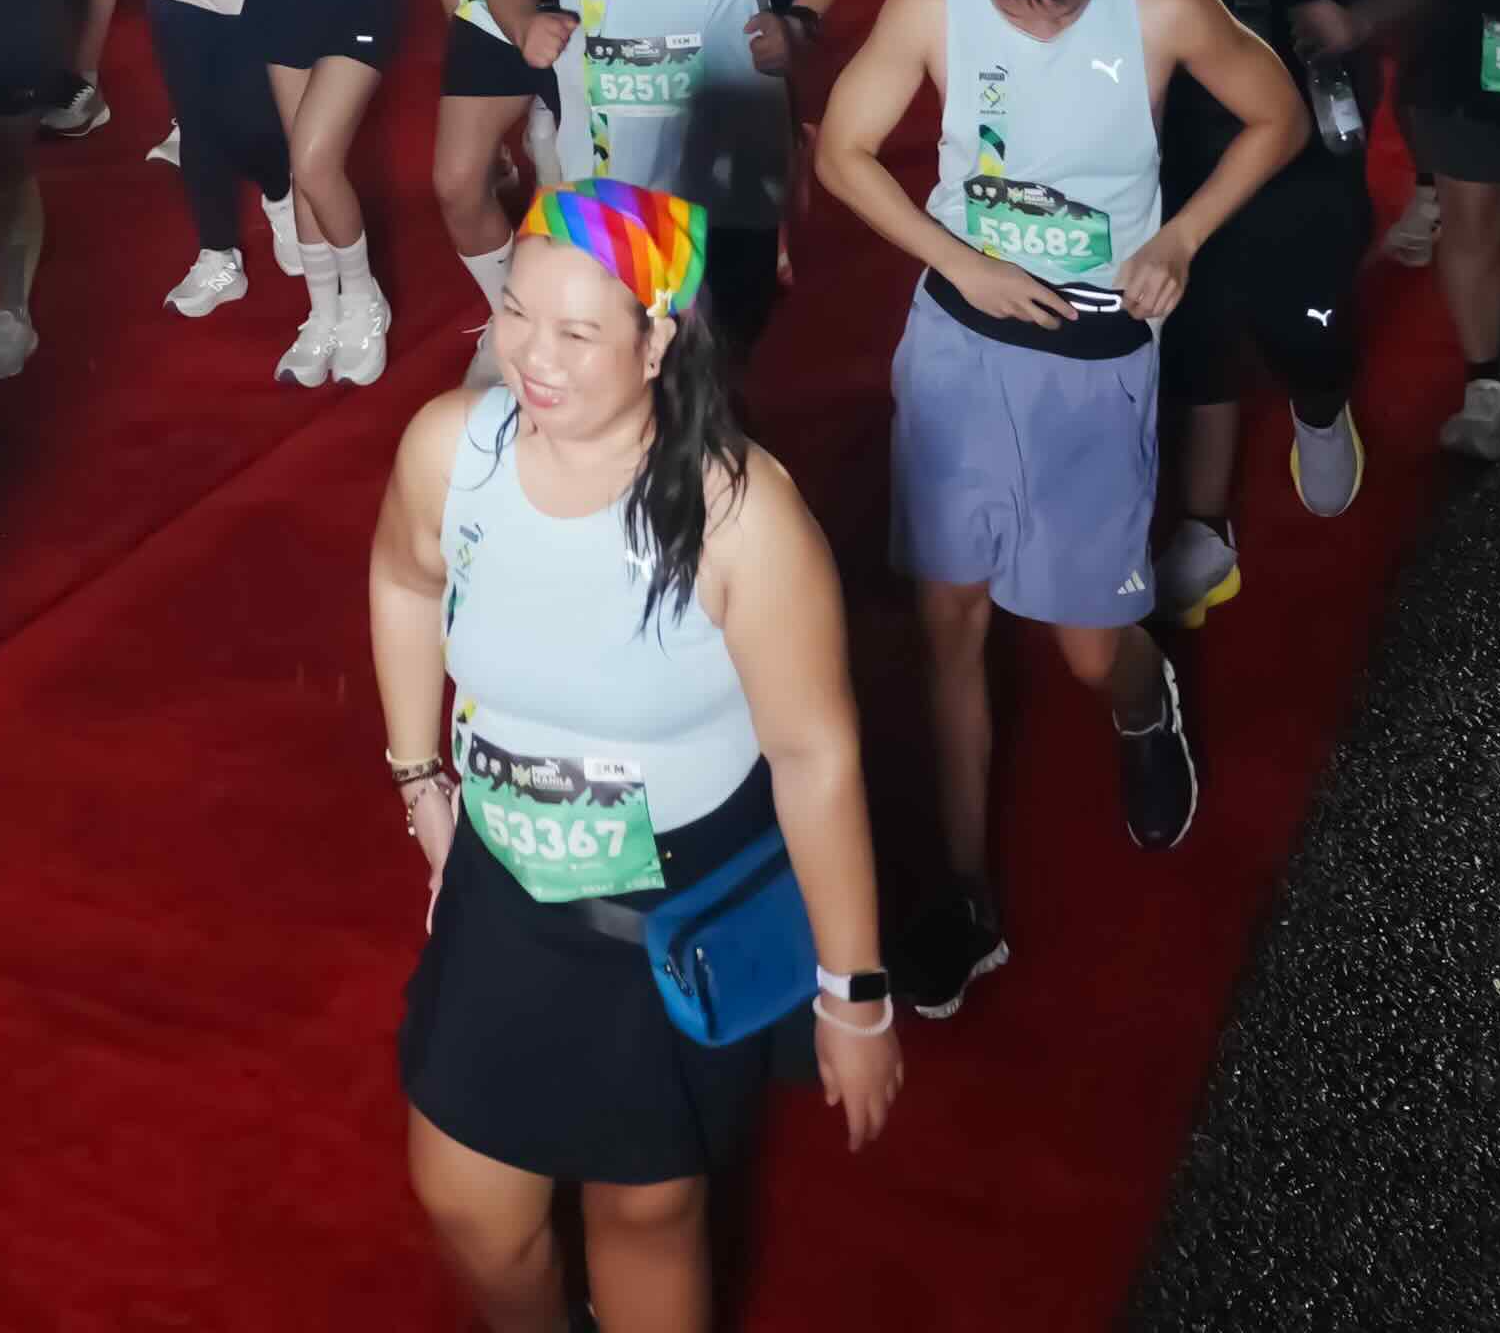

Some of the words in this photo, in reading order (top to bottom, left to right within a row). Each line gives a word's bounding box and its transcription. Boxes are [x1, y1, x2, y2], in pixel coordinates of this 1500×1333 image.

[600, 72, 691, 102] 52512
[979, 216, 1093, 258] 53682
[482, 801, 627, 861] 53367
